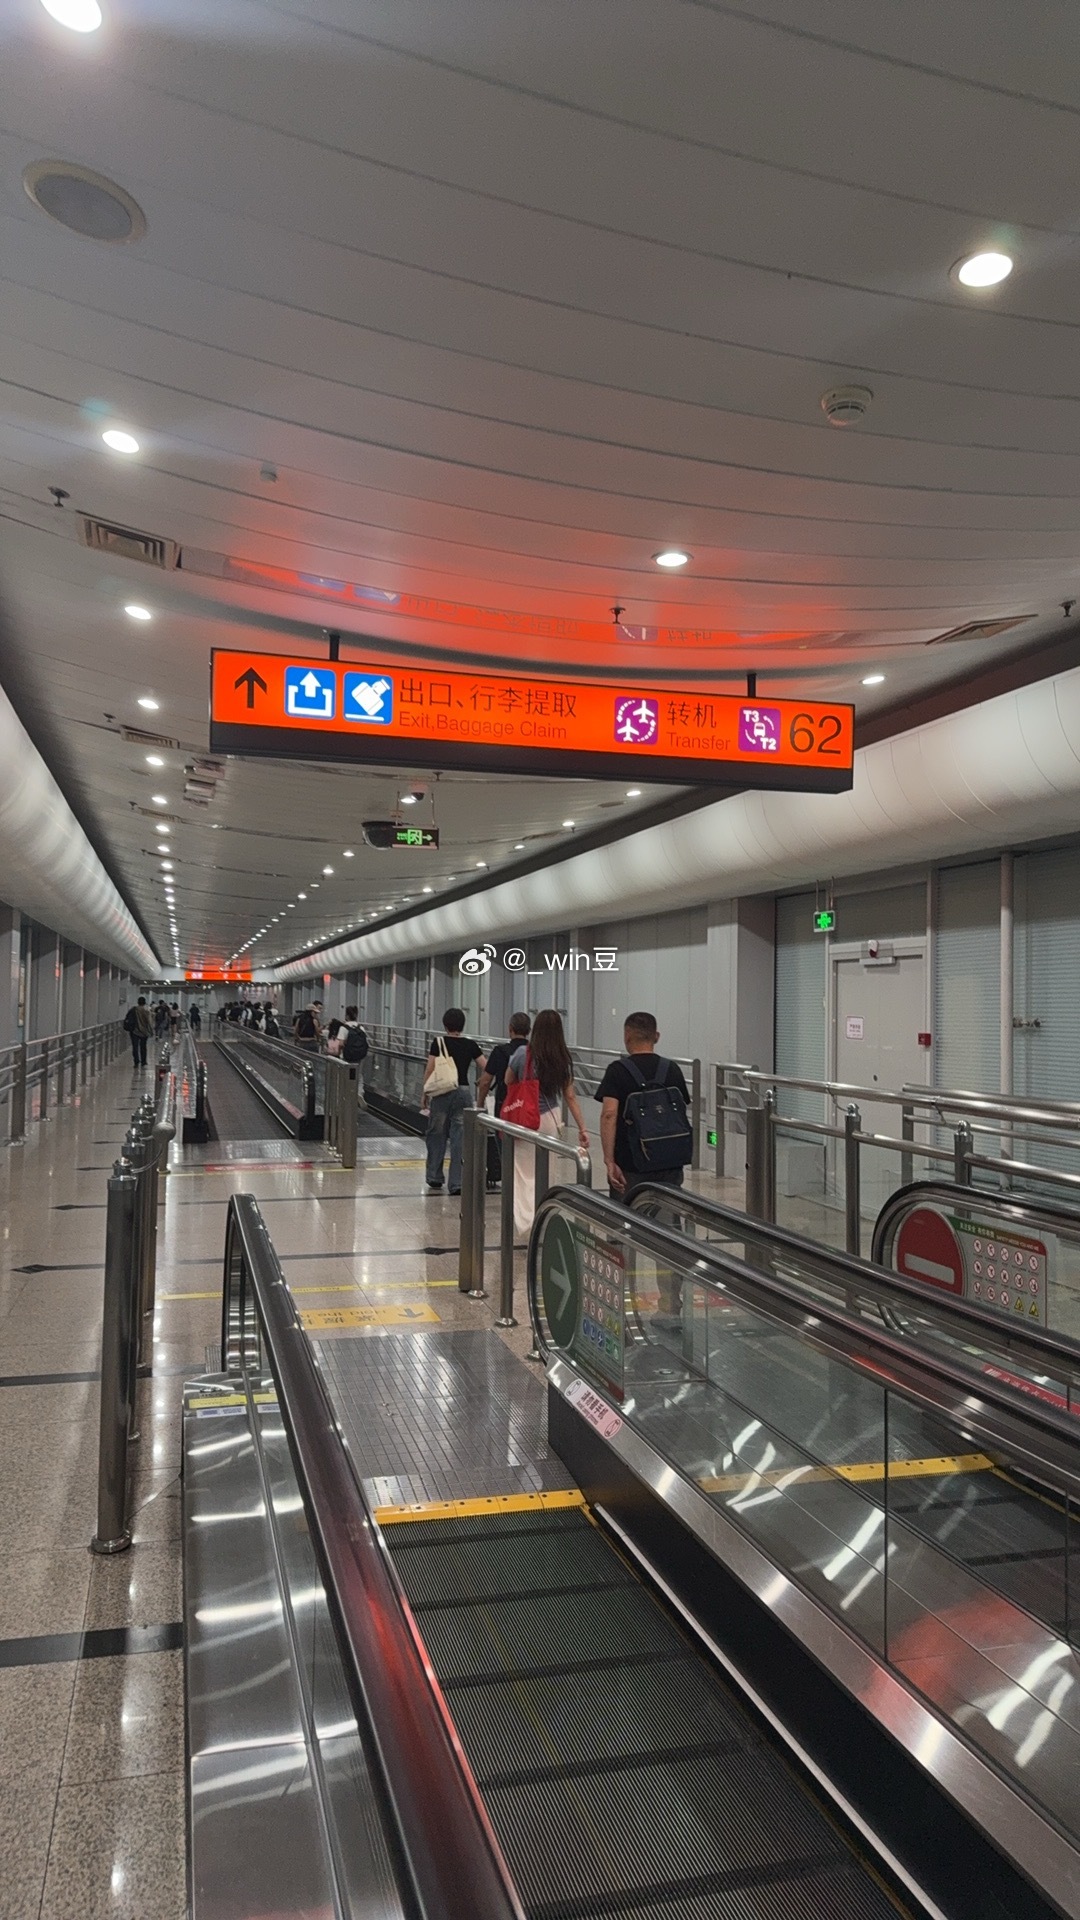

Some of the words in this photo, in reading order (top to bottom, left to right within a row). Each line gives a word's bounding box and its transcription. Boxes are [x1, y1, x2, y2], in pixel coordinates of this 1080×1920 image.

[400, 678, 577, 718] 出口、行李提取
[667, 700, 717, 729] 转机
[743, 709, 760, 722] T3
[520, 721, 567, 739] Claim
[789, 713, 842, 755] 62
[666, 732, 731, 751] Transfer
[760, 737, 777, 750] T2
